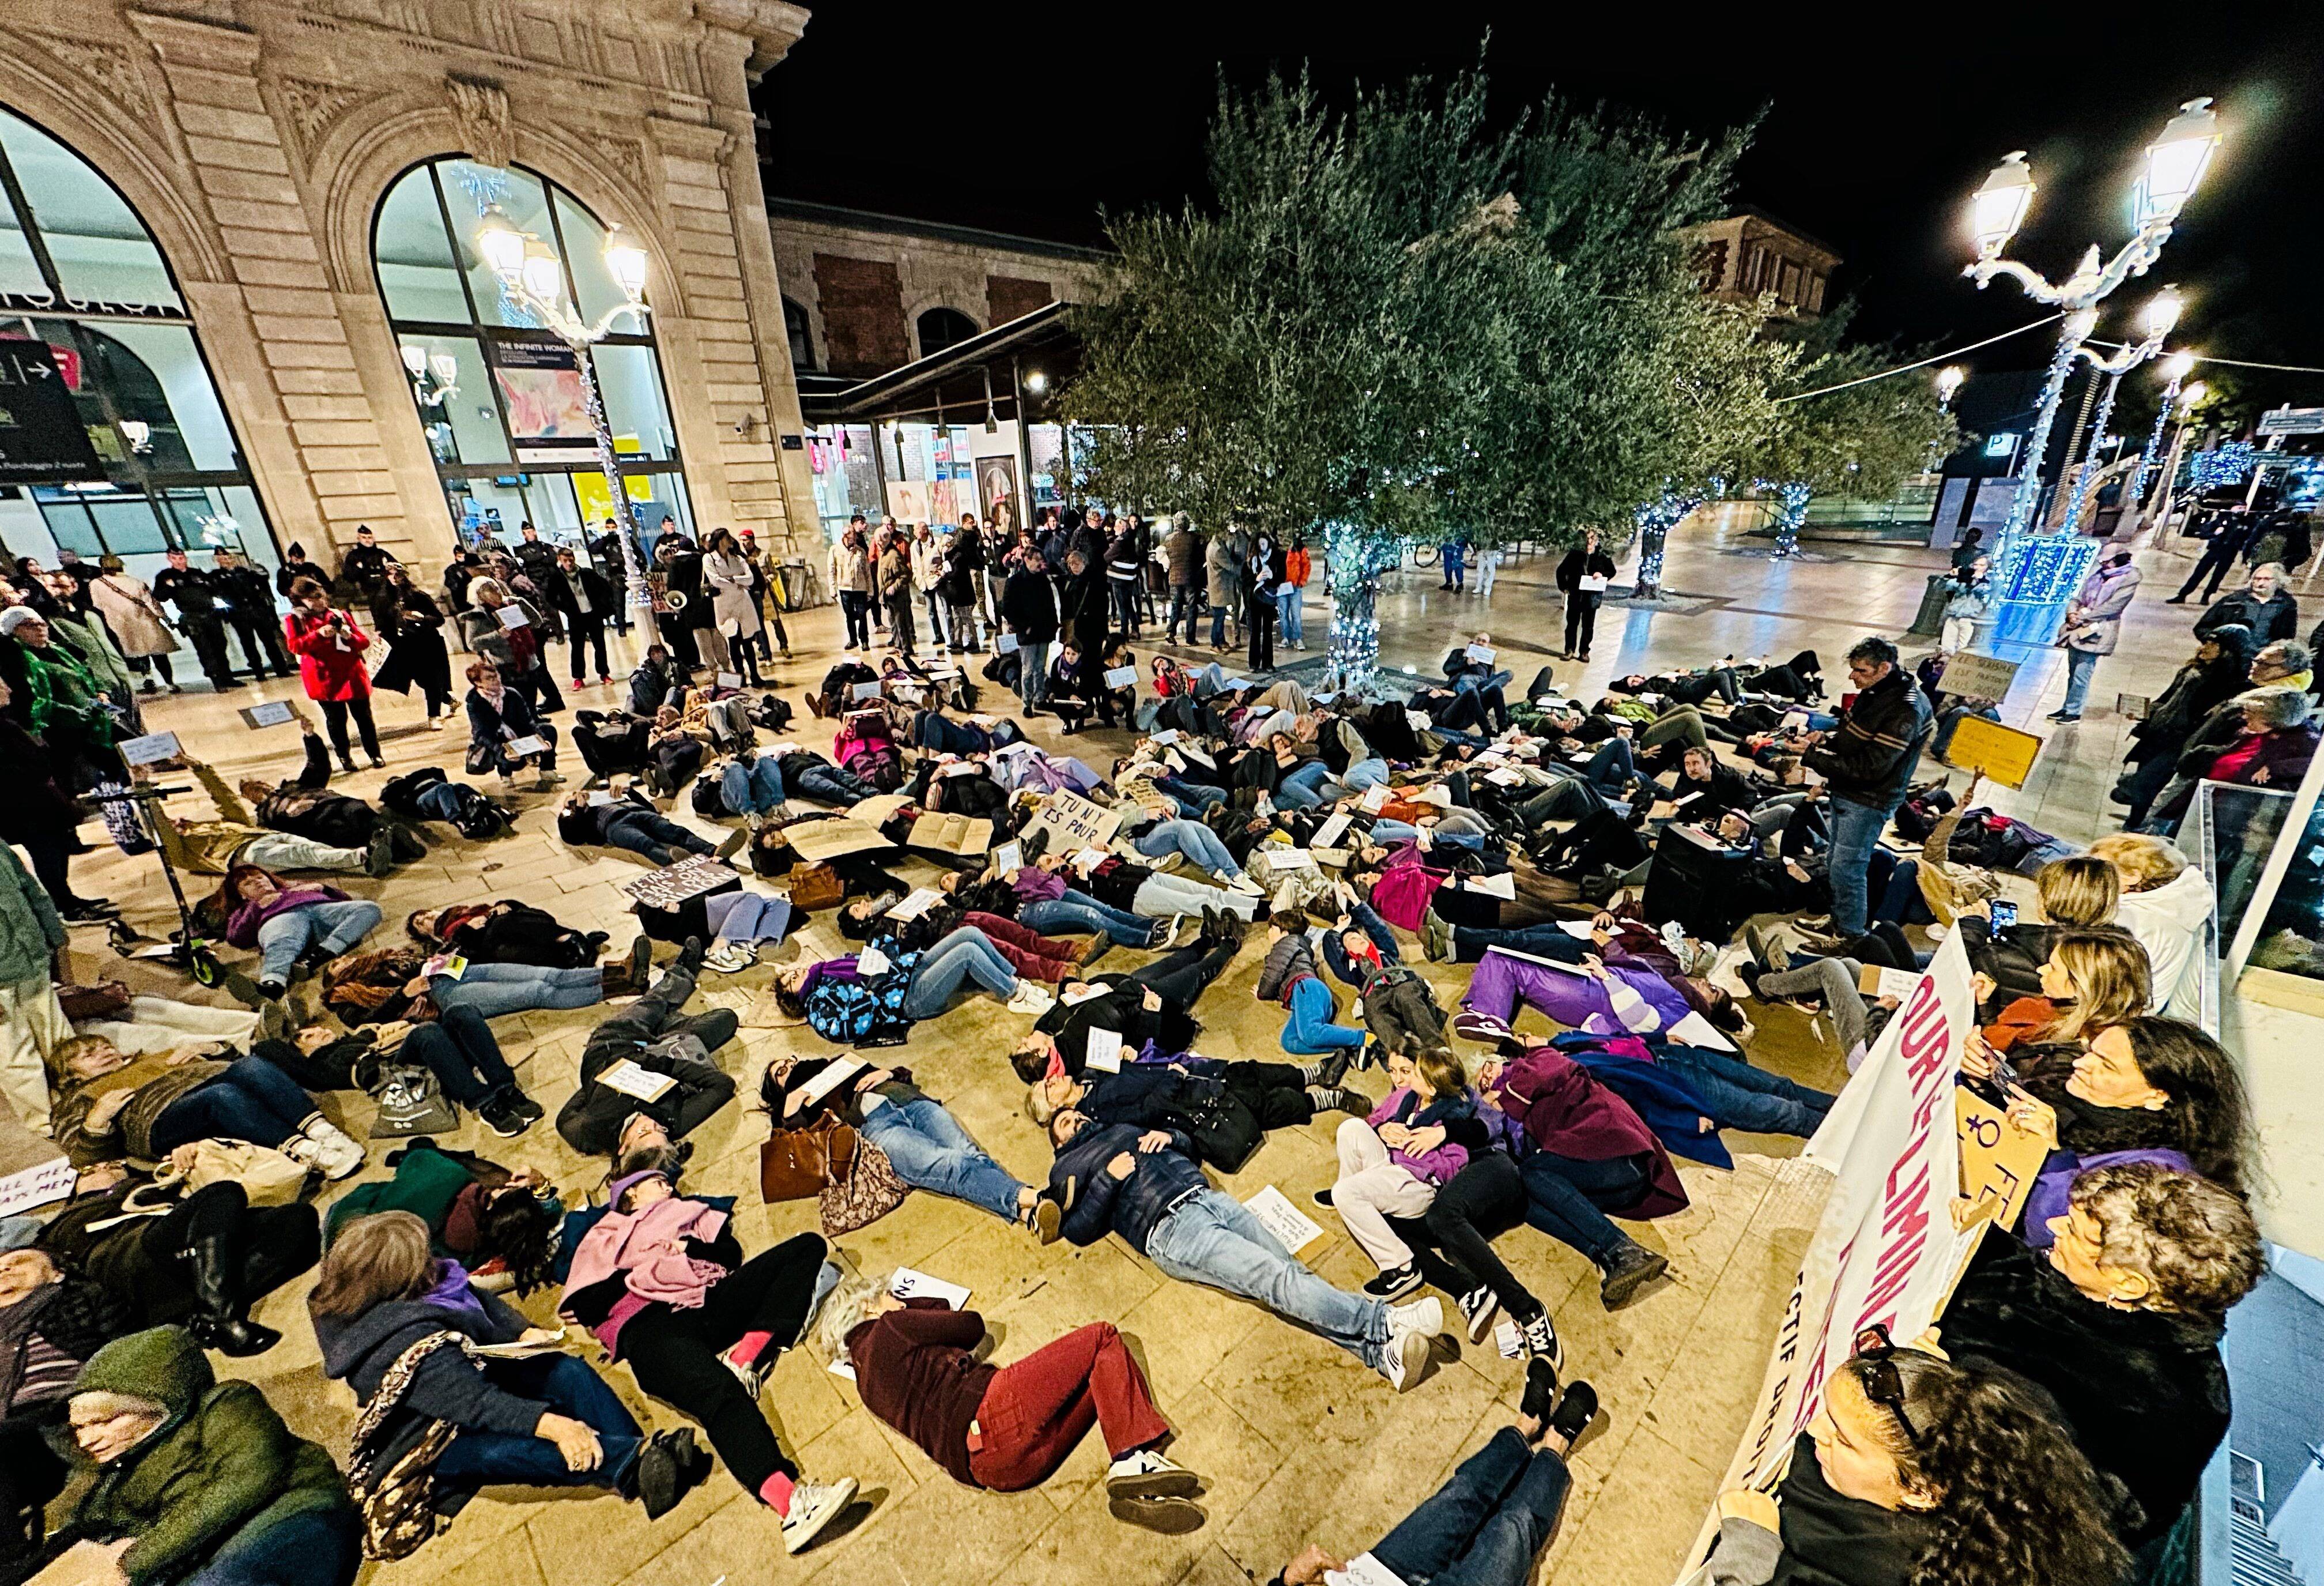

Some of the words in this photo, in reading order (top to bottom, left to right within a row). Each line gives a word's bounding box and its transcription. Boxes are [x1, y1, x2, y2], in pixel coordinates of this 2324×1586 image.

[514, 343, 543, 351] INFINITE
[544, 345, 574, 353] WOMAN
[1990, 436, 2003, 448] P
[1061, 794, 1081, 813] TU
[1044, 807, 1064, 824] ES
[1065, 819, 1099, 842] POUR
[635, 880, 676, 900] MAIS
[678, 867, 705, 880] ON
[643, 887, 675, 904] EST
[681, 871, 716, 888] DES
[656, 869, 741, 908] MILLIONS
[1900, 974, 1949, 1099] OUR
[36, 1176, 75, 1193] MEN
[1267, 1223, 1298, 1248] PAULINE
[1742, 1374, 1790, 1490] DROIT
